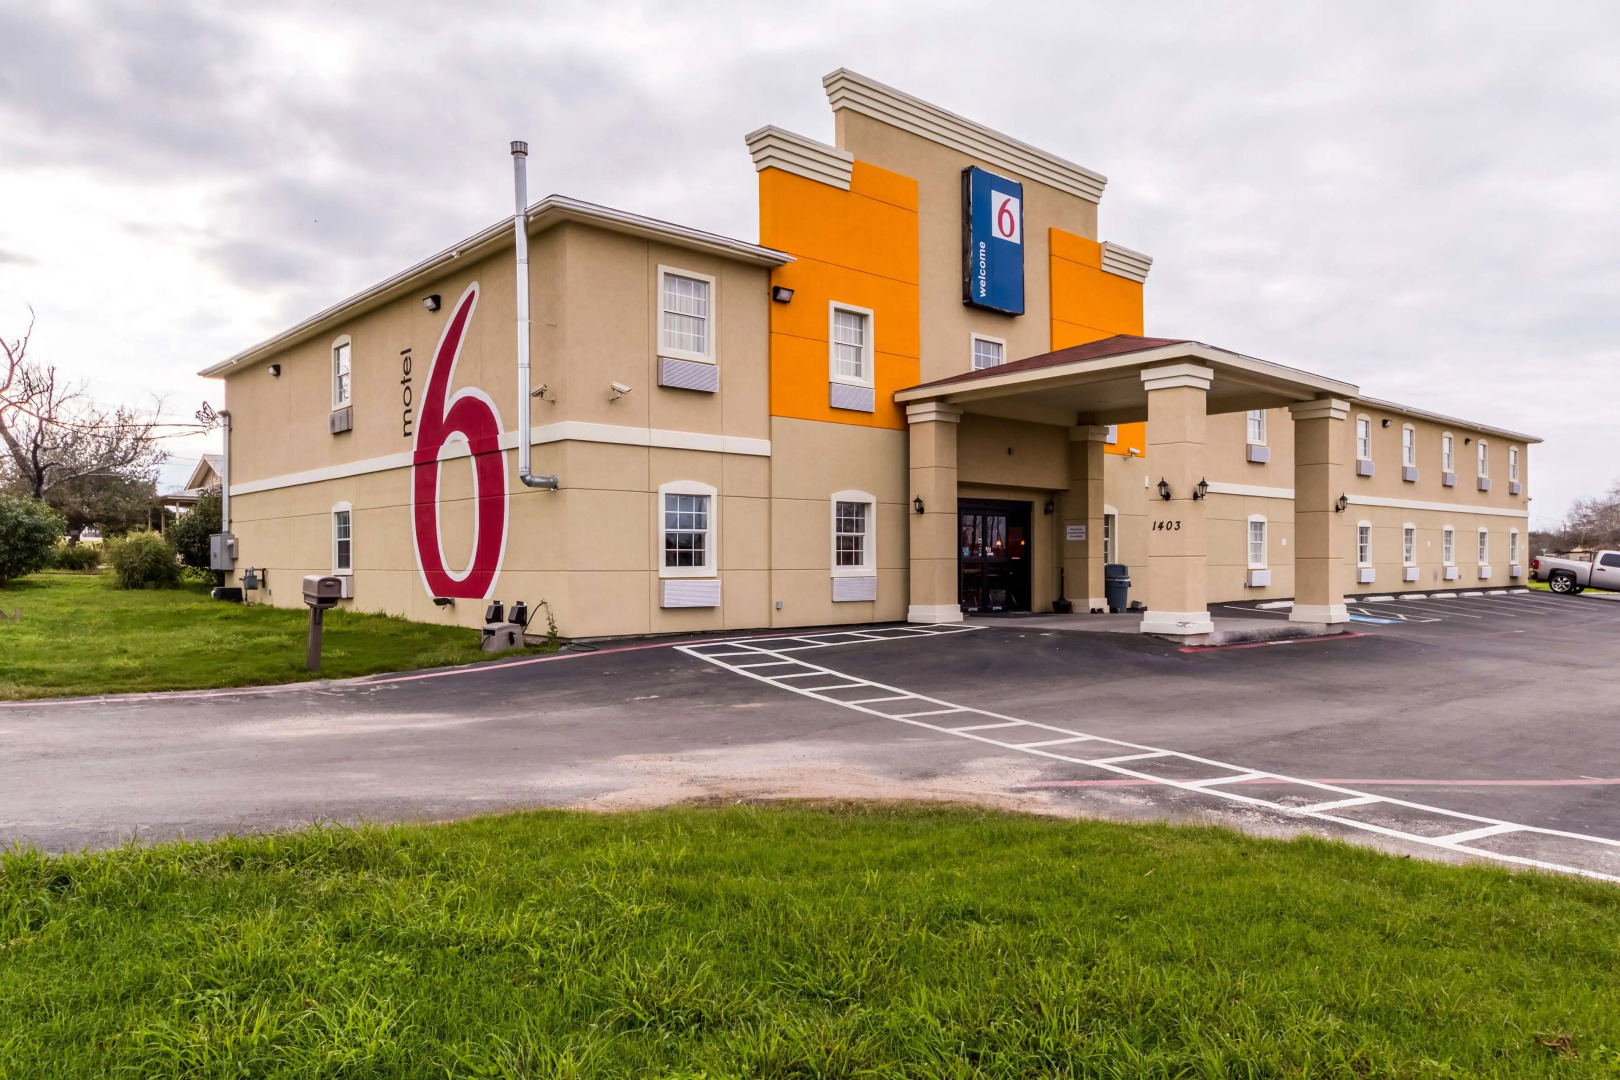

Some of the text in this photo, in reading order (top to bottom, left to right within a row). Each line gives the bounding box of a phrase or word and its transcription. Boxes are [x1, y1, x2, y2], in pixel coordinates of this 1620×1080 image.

[998, 198, 1015, 238] 6
[978, 241, 986, 297] welcome
[400, 282, 509, 599] motel 6
[1152, 520, 1181, 531] 1403
